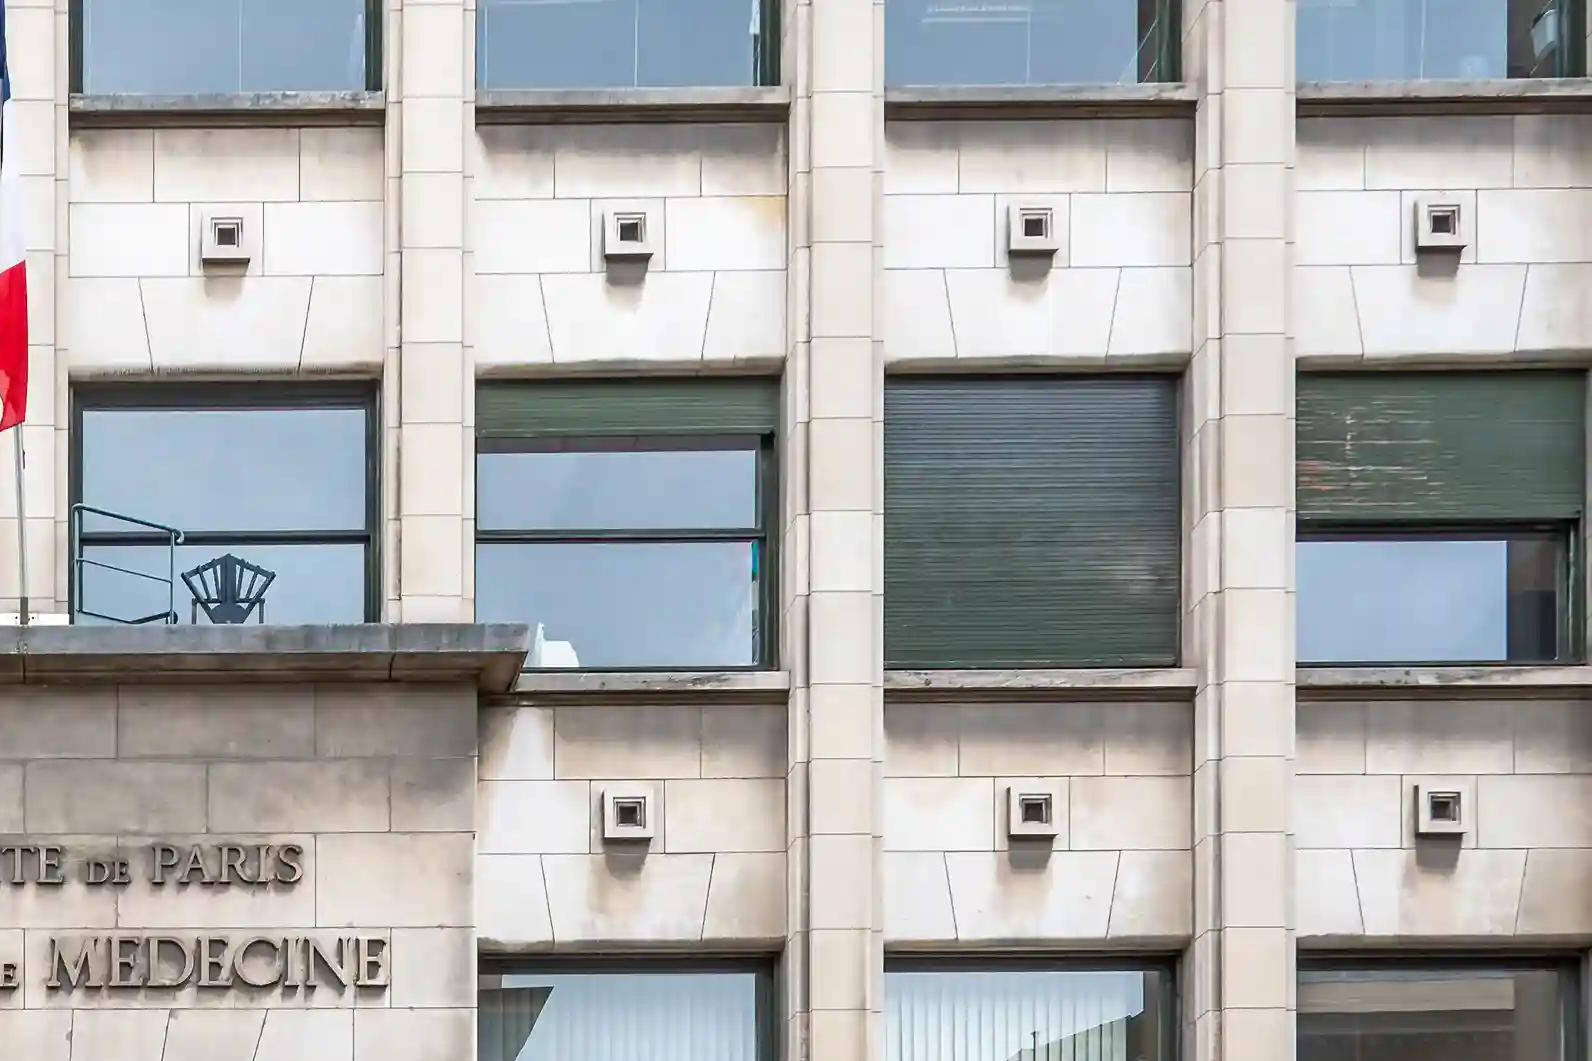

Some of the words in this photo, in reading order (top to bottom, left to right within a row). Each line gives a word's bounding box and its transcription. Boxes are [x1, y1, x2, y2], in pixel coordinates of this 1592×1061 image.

[86, 859, 131, 885] DE
[150, 843, 306, 885] PARIS
[46, 936, 390, 990] MEDECINE
